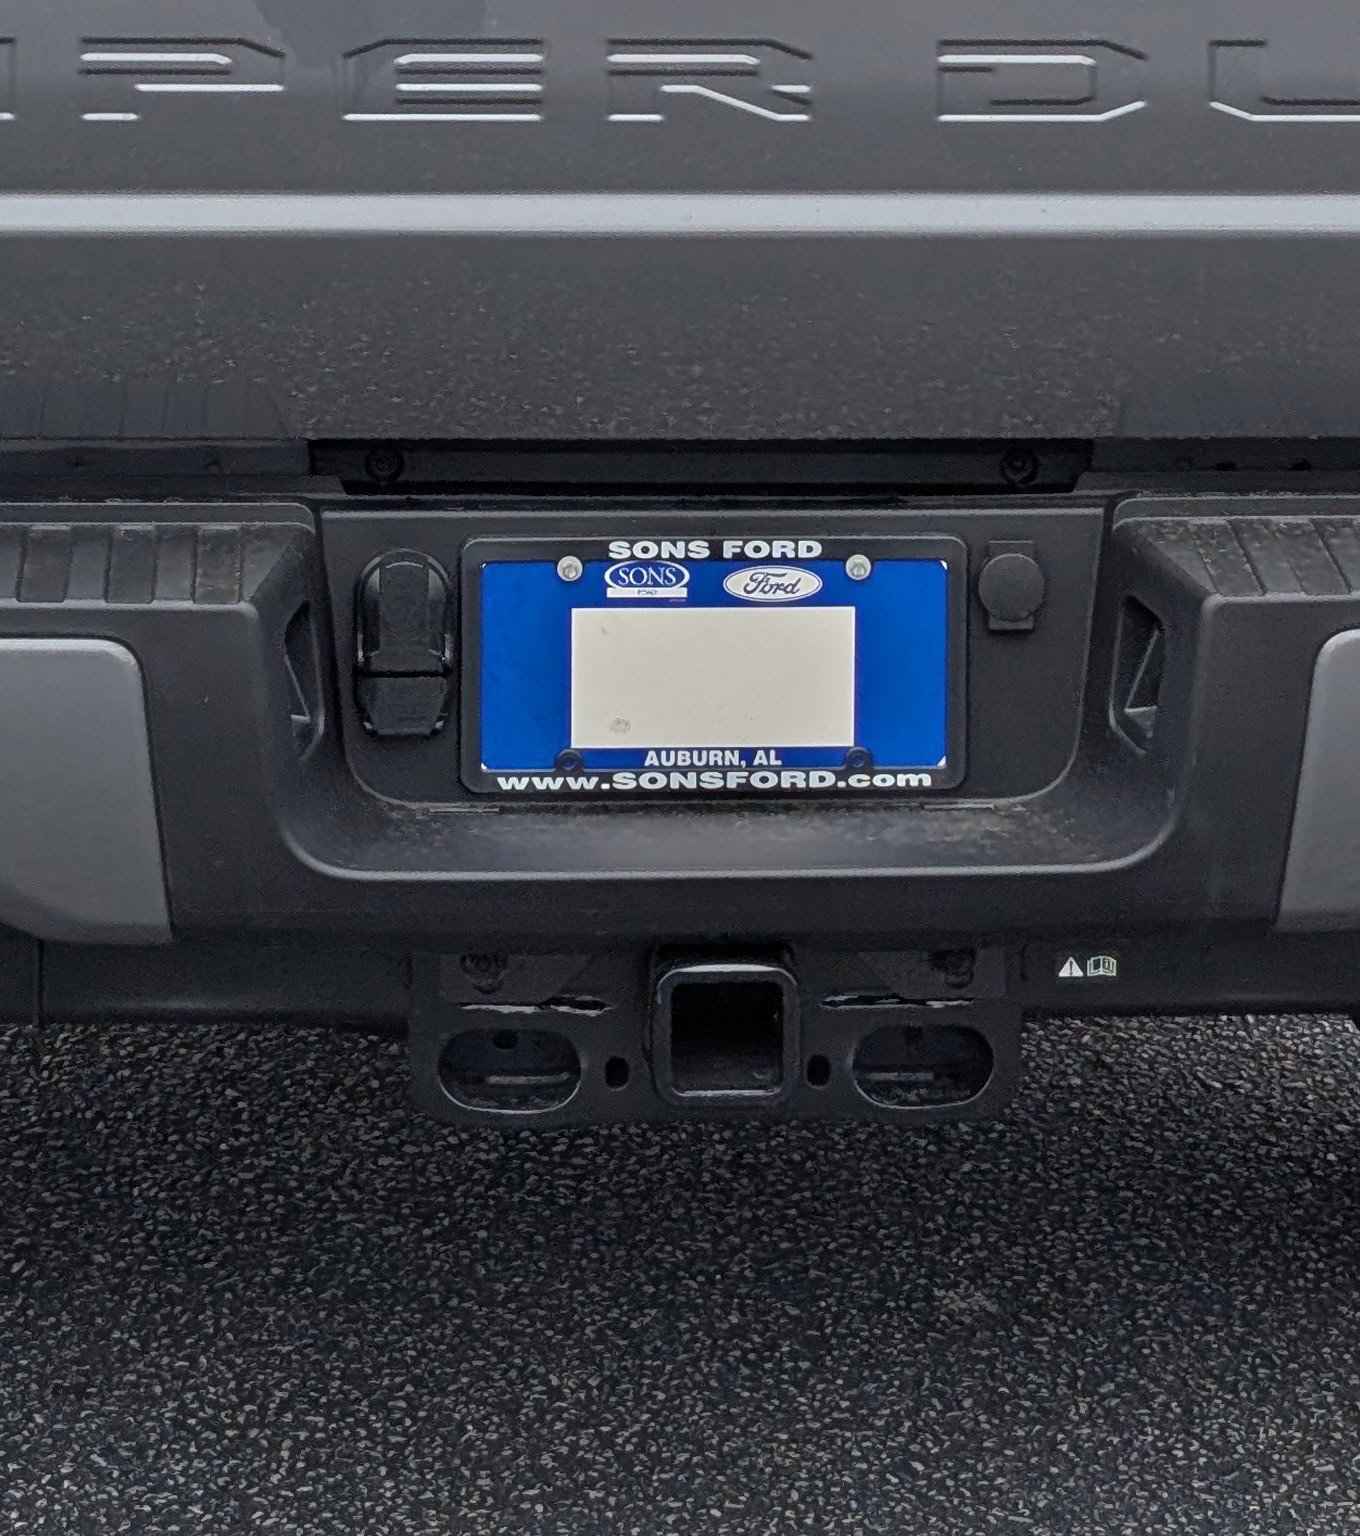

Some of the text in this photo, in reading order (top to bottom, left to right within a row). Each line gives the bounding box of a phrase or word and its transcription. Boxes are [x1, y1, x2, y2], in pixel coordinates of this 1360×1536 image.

[608, 540, 823, 559] SONS FORD
[617, 567, 677, 586] SONS
[743, 571, 801, 596] Ford
[644, 750, 782, 768] AUBURN, AL
[497, 771, 932, 790] www.SONSFORD.com
